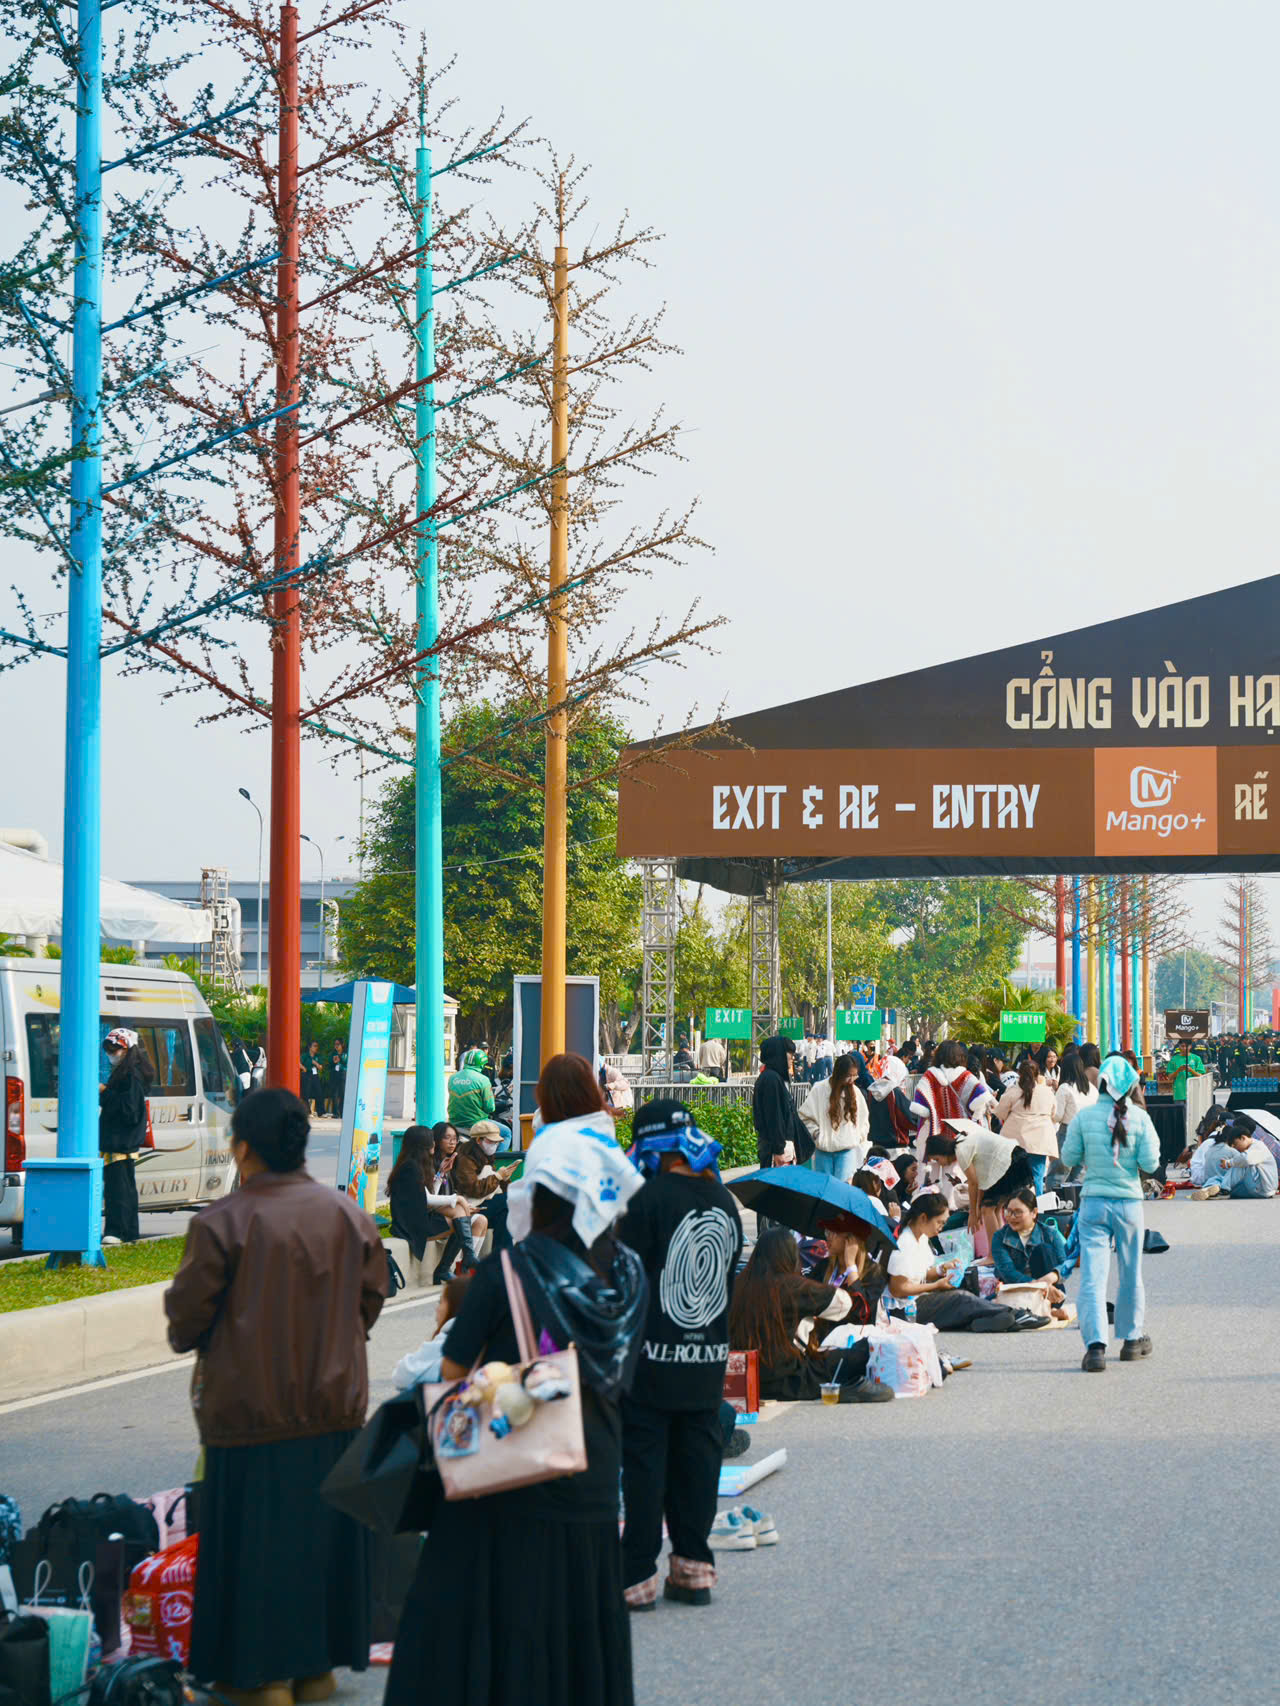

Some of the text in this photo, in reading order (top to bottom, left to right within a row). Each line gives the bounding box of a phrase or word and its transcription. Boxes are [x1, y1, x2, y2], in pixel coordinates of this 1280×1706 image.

[1006, 651, 1112, 729] CỔNG
[1131, 660, 1209, 728] VÀO
[713, 785, 787, 830] EXIT
[802, 785, 823, 829] &
[1235, 771, 1269, 820] RẼ
[1106, 811, 1206, 838] Mango+
[715, 1009, 743, 1023] EXIT
[845, 1011, 873, 1025] EXIT
